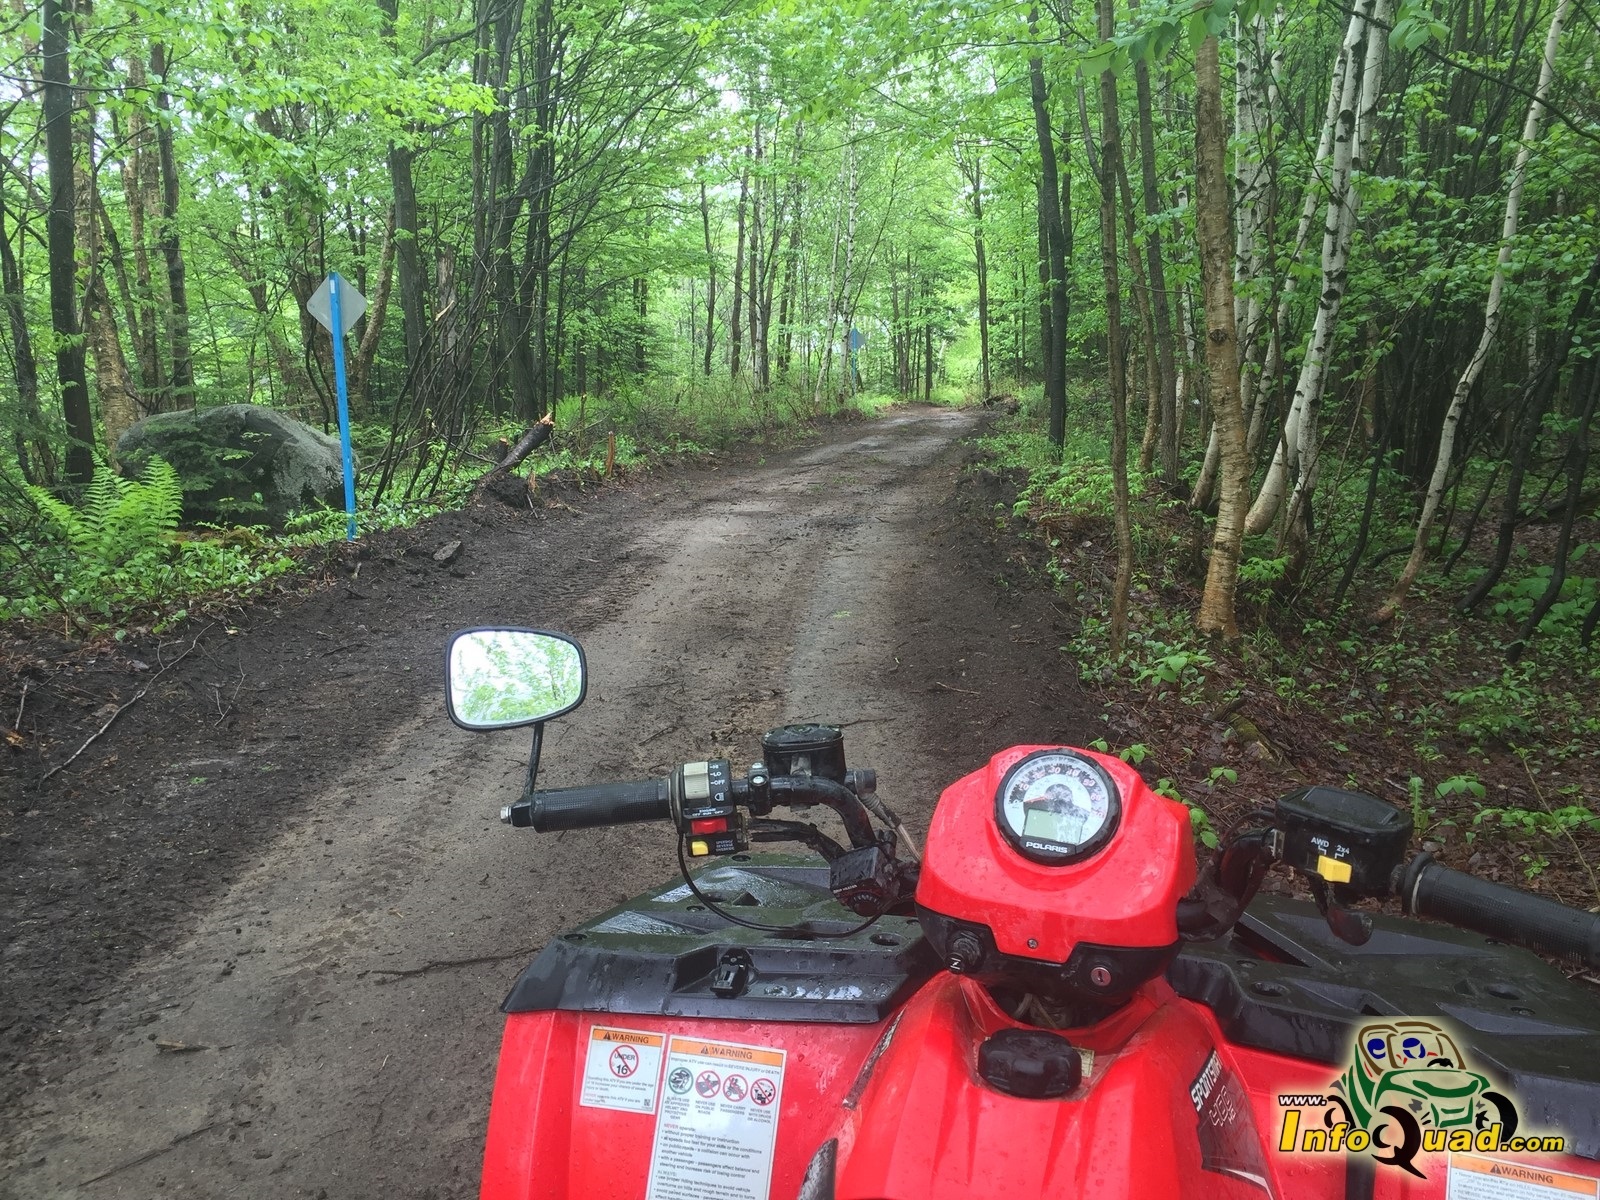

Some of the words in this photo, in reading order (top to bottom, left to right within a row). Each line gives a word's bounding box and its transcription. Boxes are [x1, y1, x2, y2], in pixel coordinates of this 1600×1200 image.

[1026, 841, 1067, 853] POLARIS
[1311, 837, 1329, 848] AWD
[1336, 845, 1349, 855] 2x4
[613, 1034, 649, 1044] WARNING
[712, 1047, 752, 1060] WARNING
[617, 1064, 628, 1074] 16
[1501, 1167, 1553, 1184] WARNING
